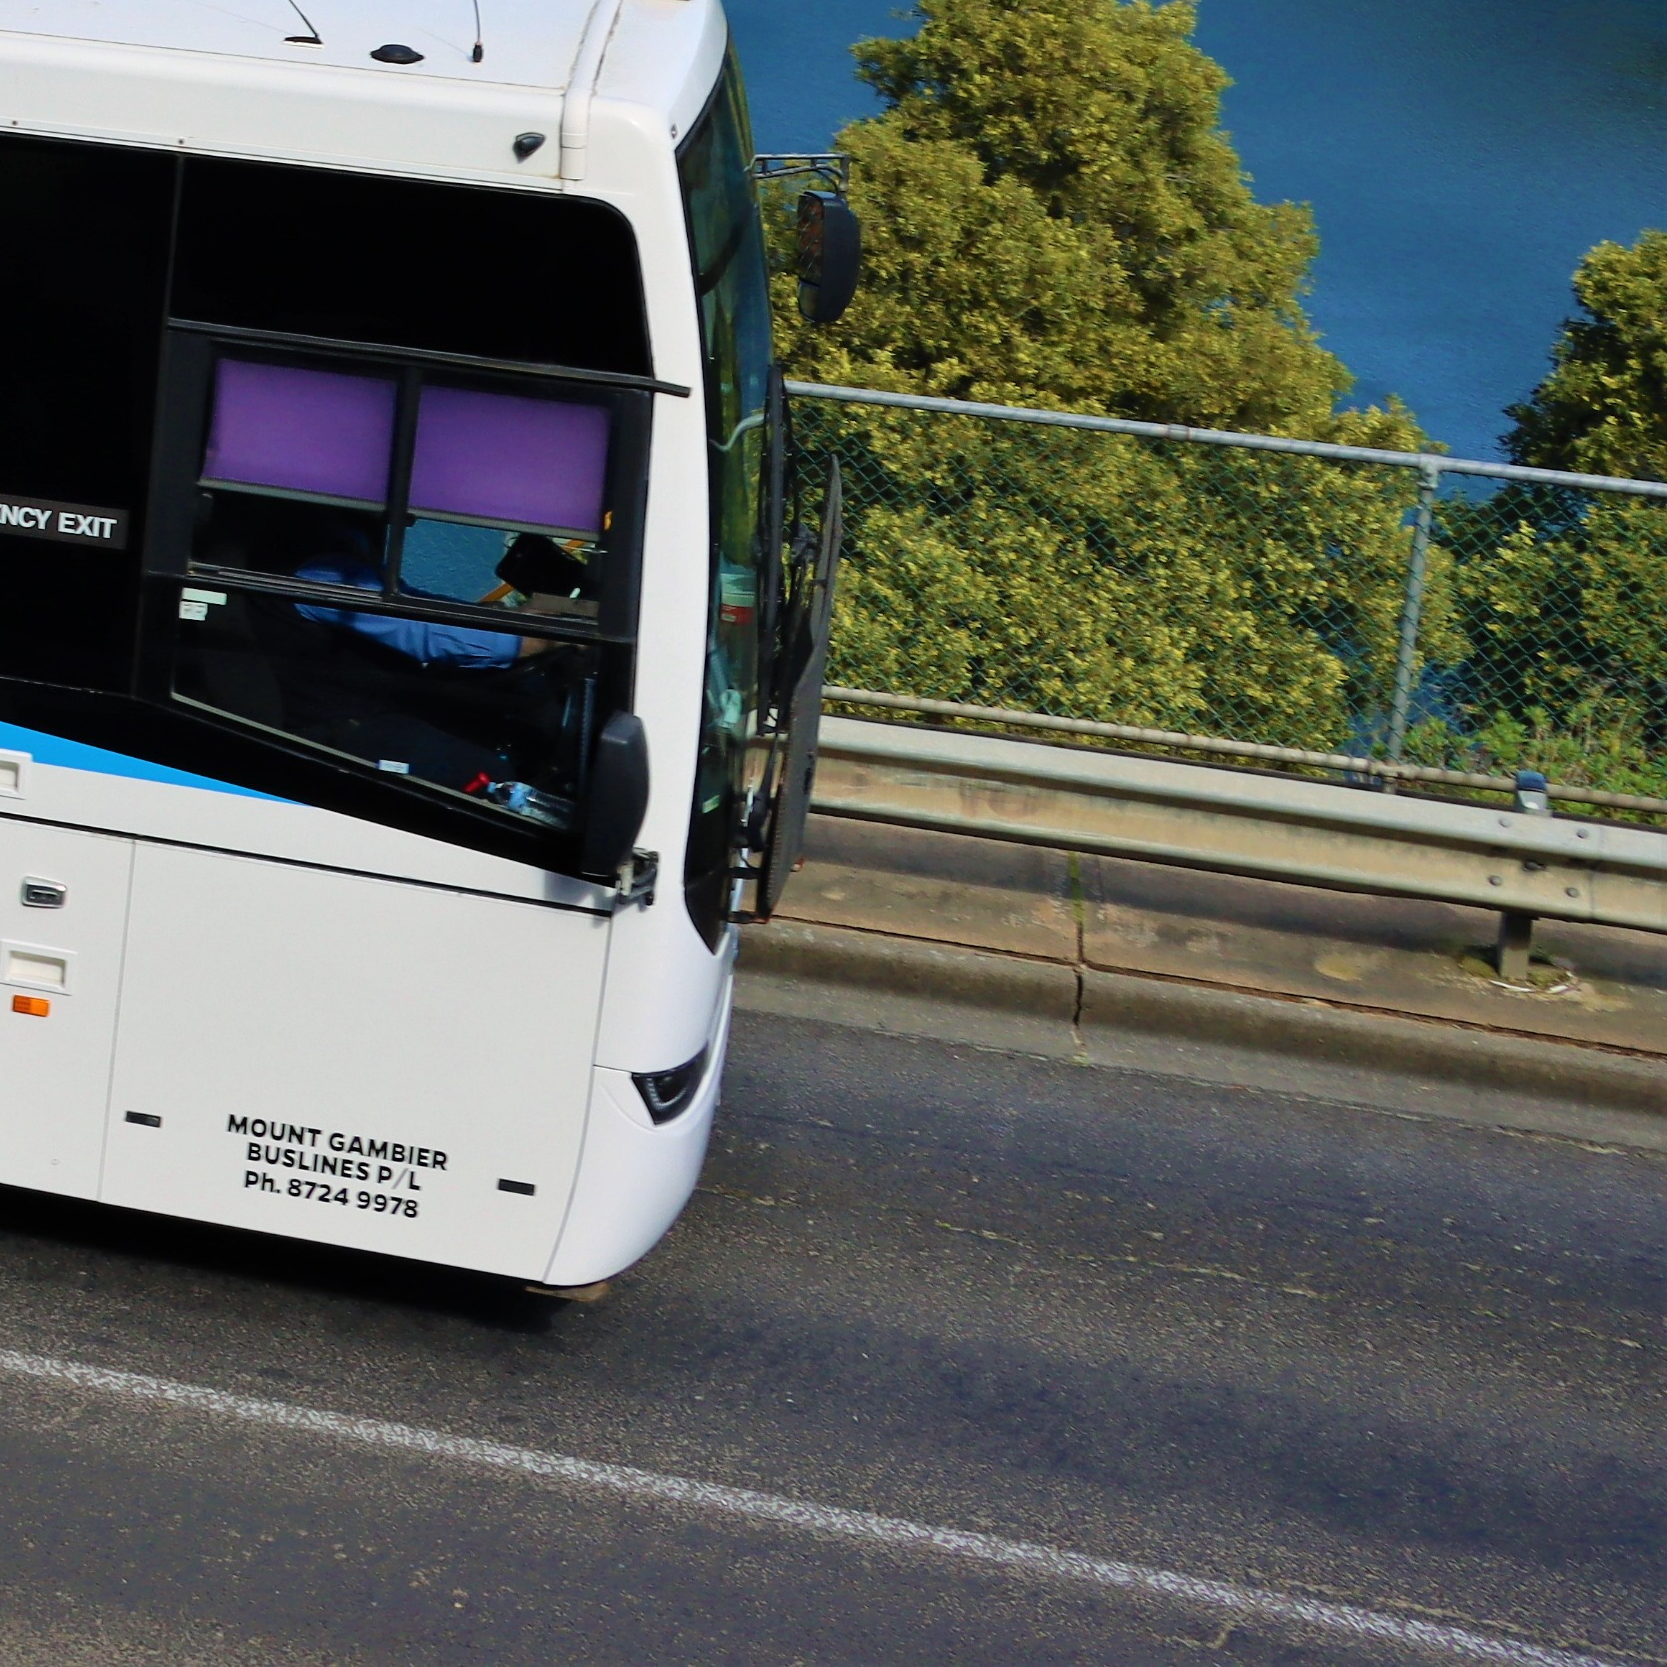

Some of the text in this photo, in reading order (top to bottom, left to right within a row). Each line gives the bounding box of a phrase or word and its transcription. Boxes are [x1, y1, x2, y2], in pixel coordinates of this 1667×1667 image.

[57, 511, 118, 540] EXIT
[227, 1113, 449, 1171] MOUNT GAMBIER
[246, 1141, 422, 1191] BUSLINES P/L
[244, 1170, 419, 1219] Ph. 8724 9978
